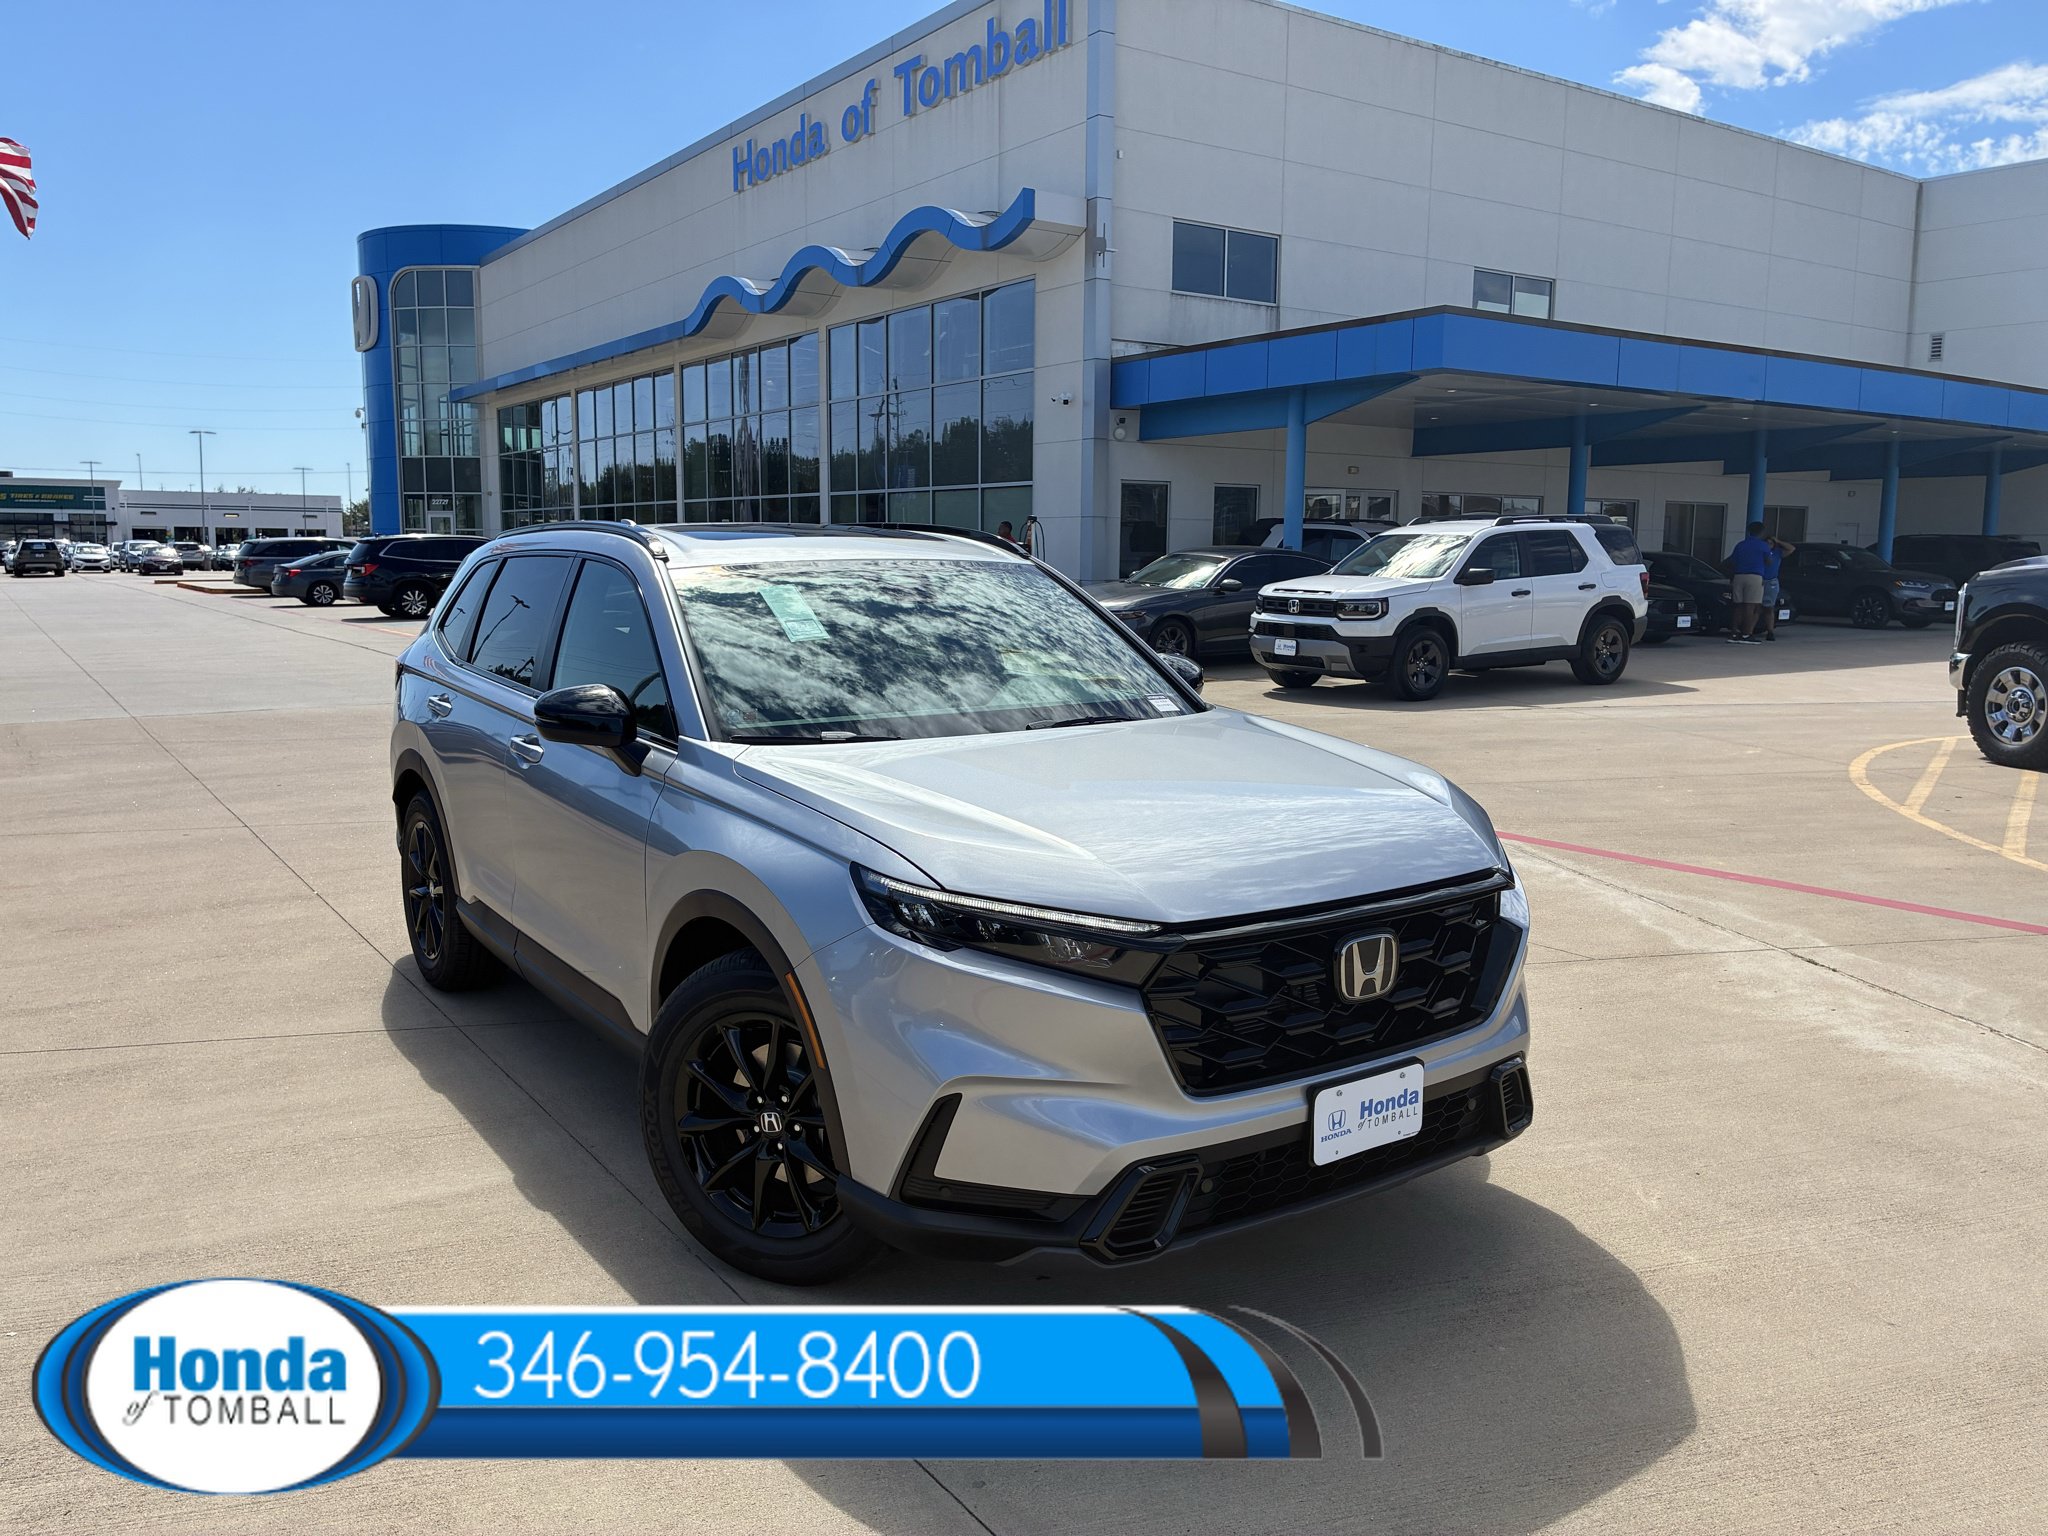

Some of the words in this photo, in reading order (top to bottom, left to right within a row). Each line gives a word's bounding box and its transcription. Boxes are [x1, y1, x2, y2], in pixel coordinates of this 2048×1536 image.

[733, 113, 827, 193] Honda
[841, 79, 879, 143] of
[894, 0, 1069, 117] Tomball
[1359, 1088, 1419, 1120] Honda
[1357, 1117, 1367, 1131] of
[1367, 1106, 1418, 1129] TOMBALL
[1320, 1128, 1352, 1143] HONDA
